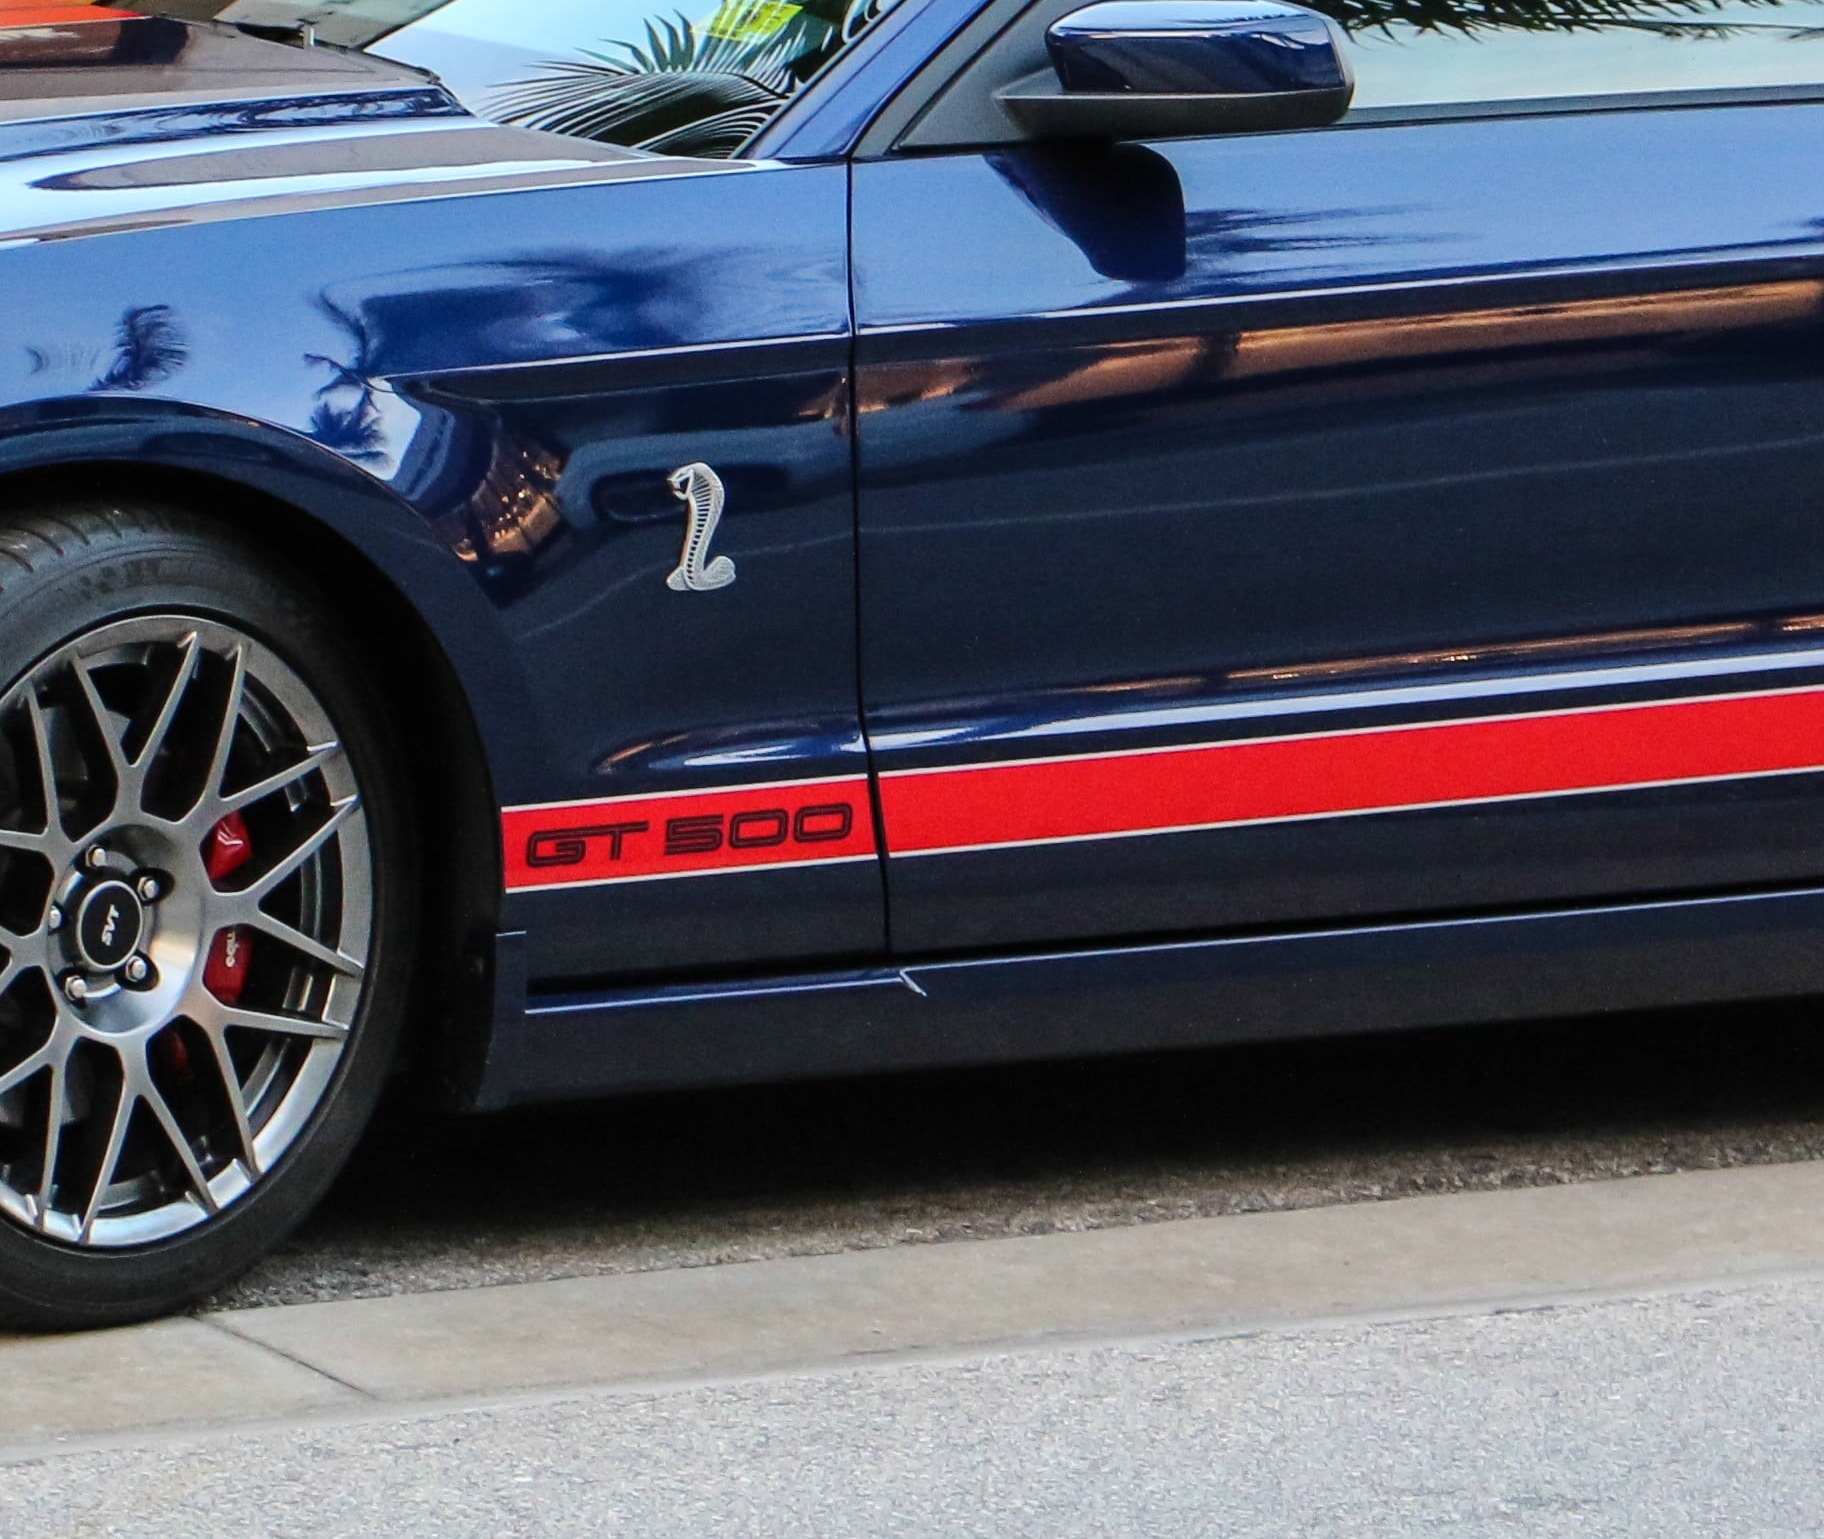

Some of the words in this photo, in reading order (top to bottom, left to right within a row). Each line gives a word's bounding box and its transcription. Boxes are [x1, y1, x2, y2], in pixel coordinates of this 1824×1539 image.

[527, 821, 650, 869] GT
[664, 802, 853, 857] 500
[101, 904, 120, 946] SVT
